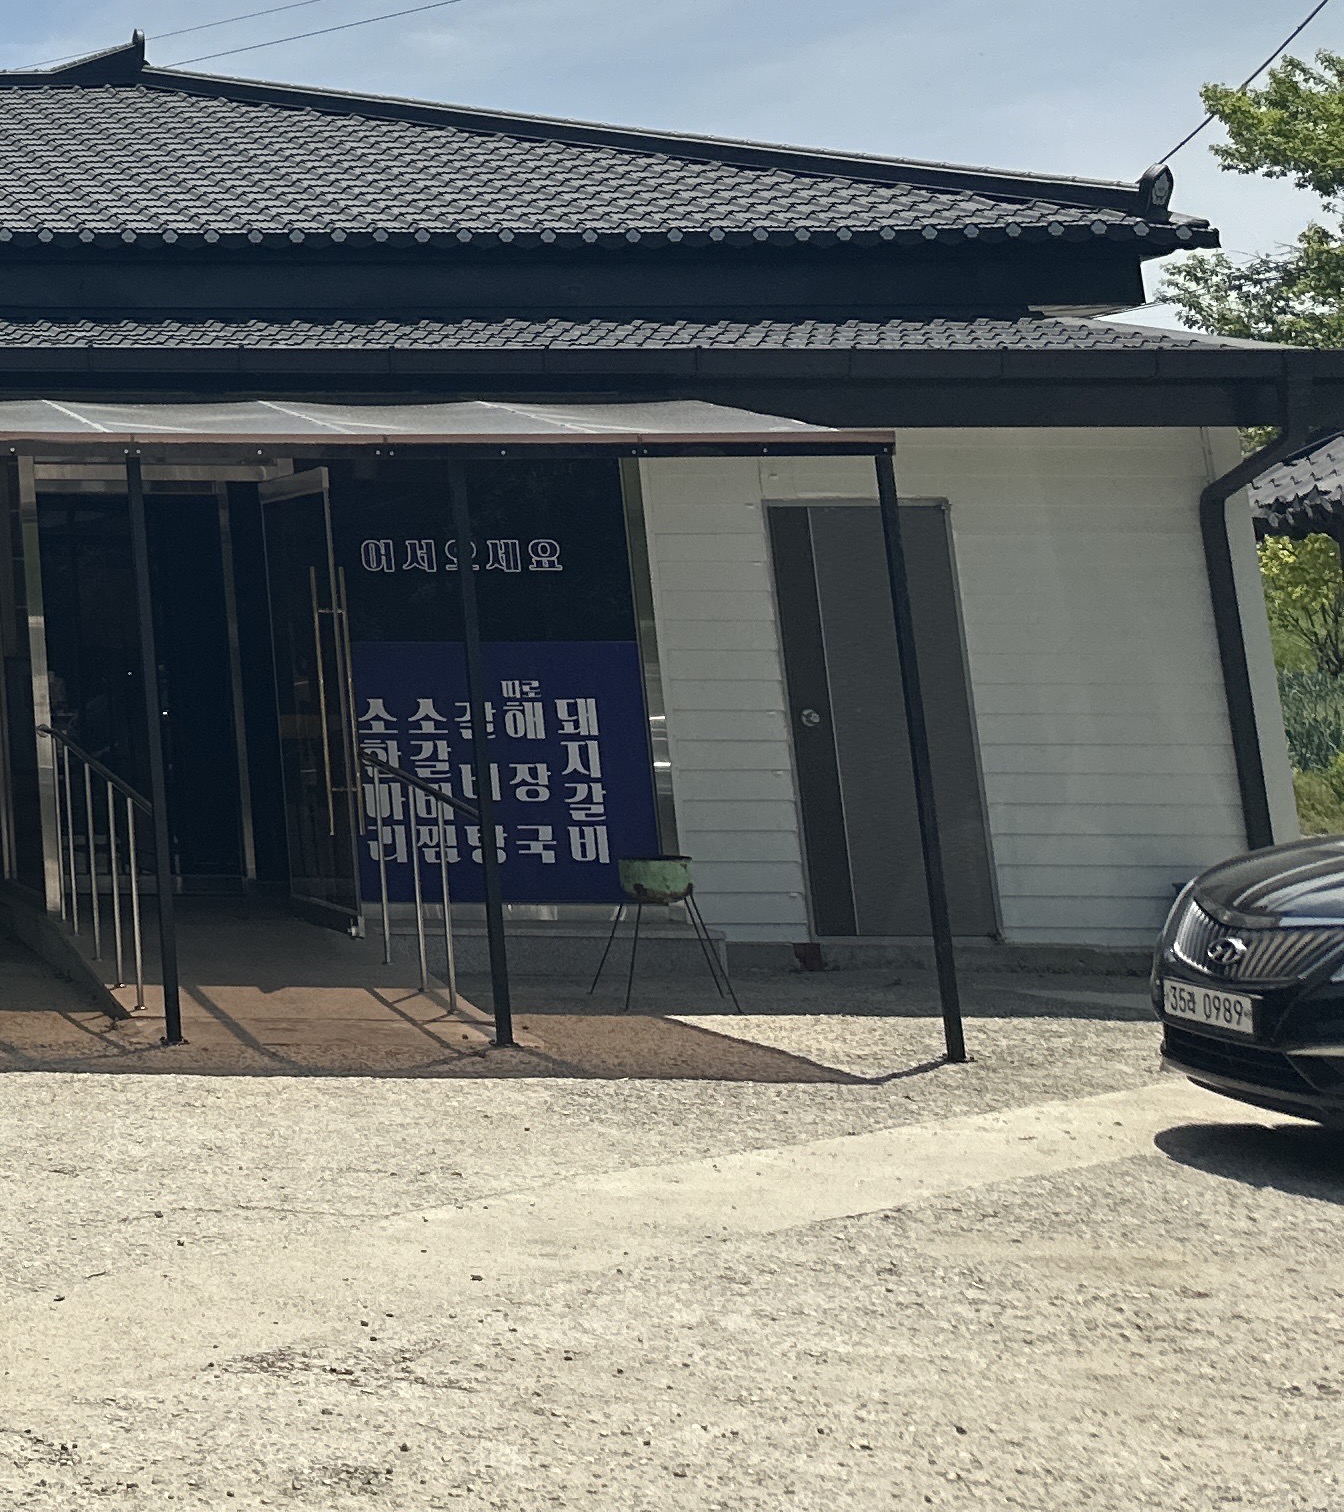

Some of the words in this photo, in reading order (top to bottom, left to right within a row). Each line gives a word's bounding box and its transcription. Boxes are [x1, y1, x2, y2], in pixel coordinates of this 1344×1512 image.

[360, 539, 563, 573] 어서오세요
[500, 679, 541, 698] 따로
[503, 701, 556, 863] 해장국
[554, 698, 611, 864] 돼지갈비
[1203, 993, 1243, 1026] 0989
